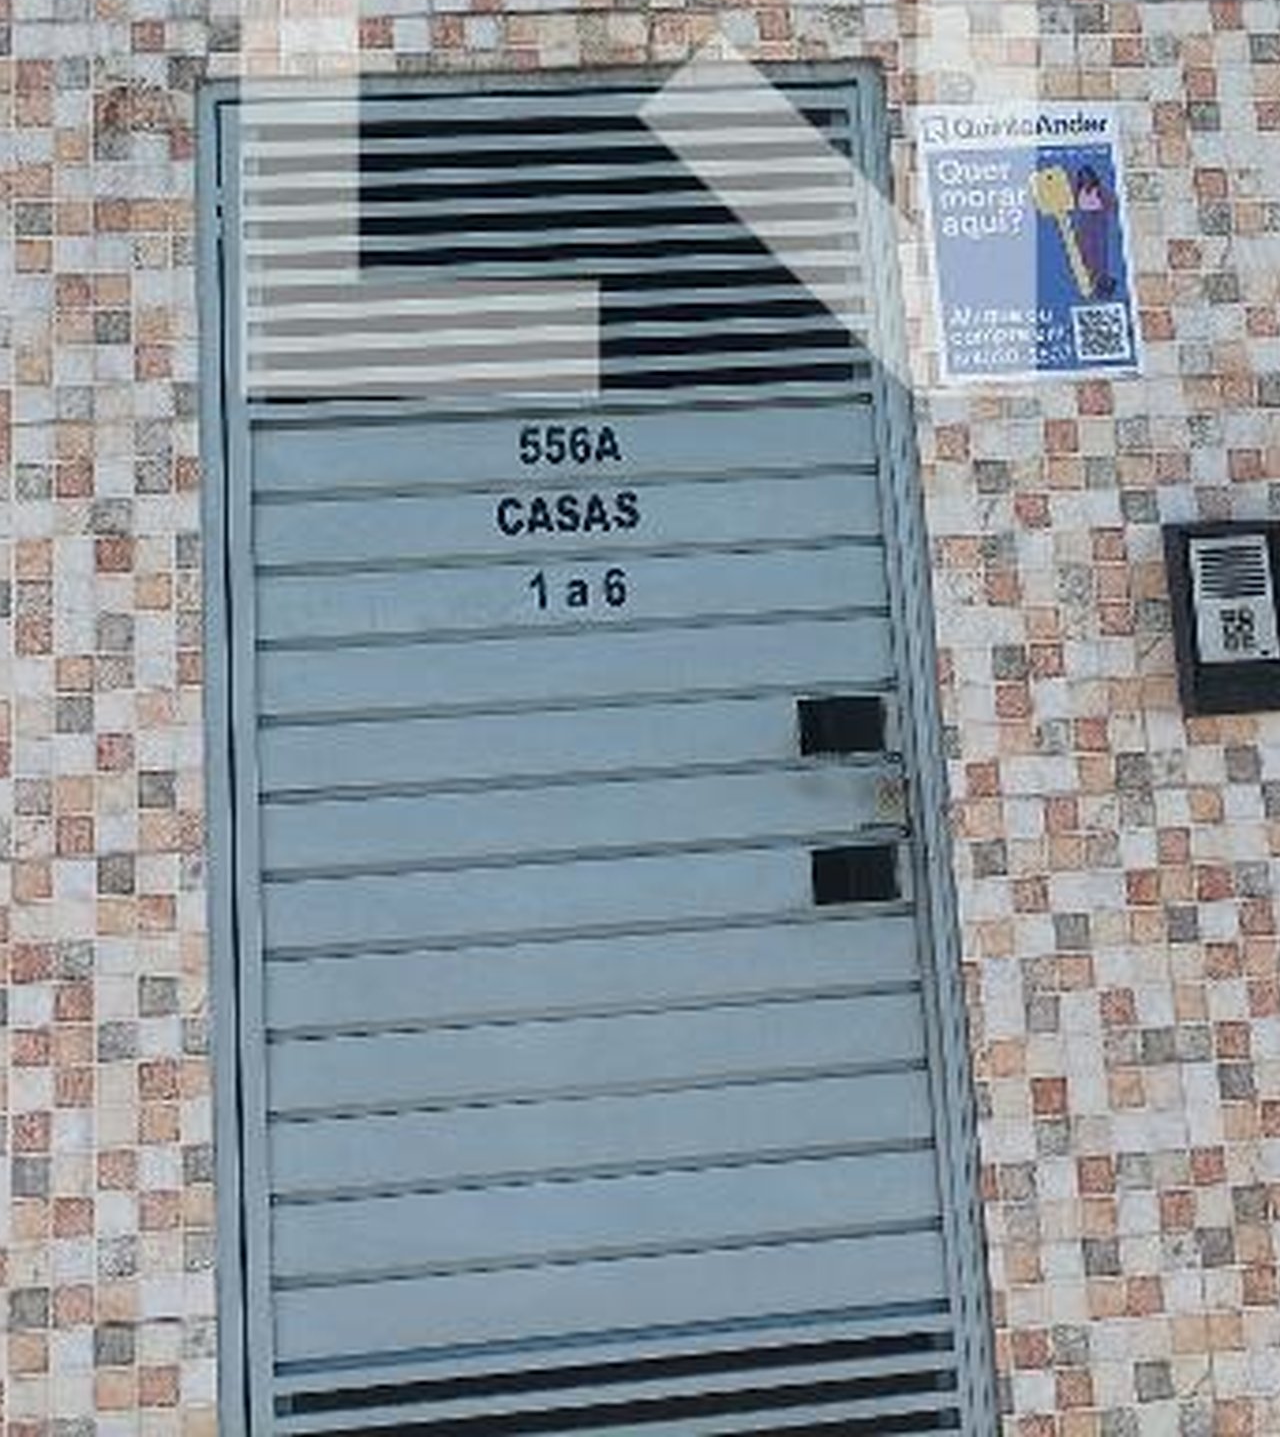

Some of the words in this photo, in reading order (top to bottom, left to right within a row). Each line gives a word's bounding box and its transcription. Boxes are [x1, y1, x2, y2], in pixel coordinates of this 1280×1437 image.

[938, 159, 1011, 185] Quer
[941, 188, 1026, 210] morar
[942, 210, 1024, 240] aqui?
[519, 426, 622, 464] 556A
[496, 491, 641, 536] CASAS
[529, 570, 548, 610] 1
[566, 578, 589, 607] a
[605, 567, 627, 607] 6
